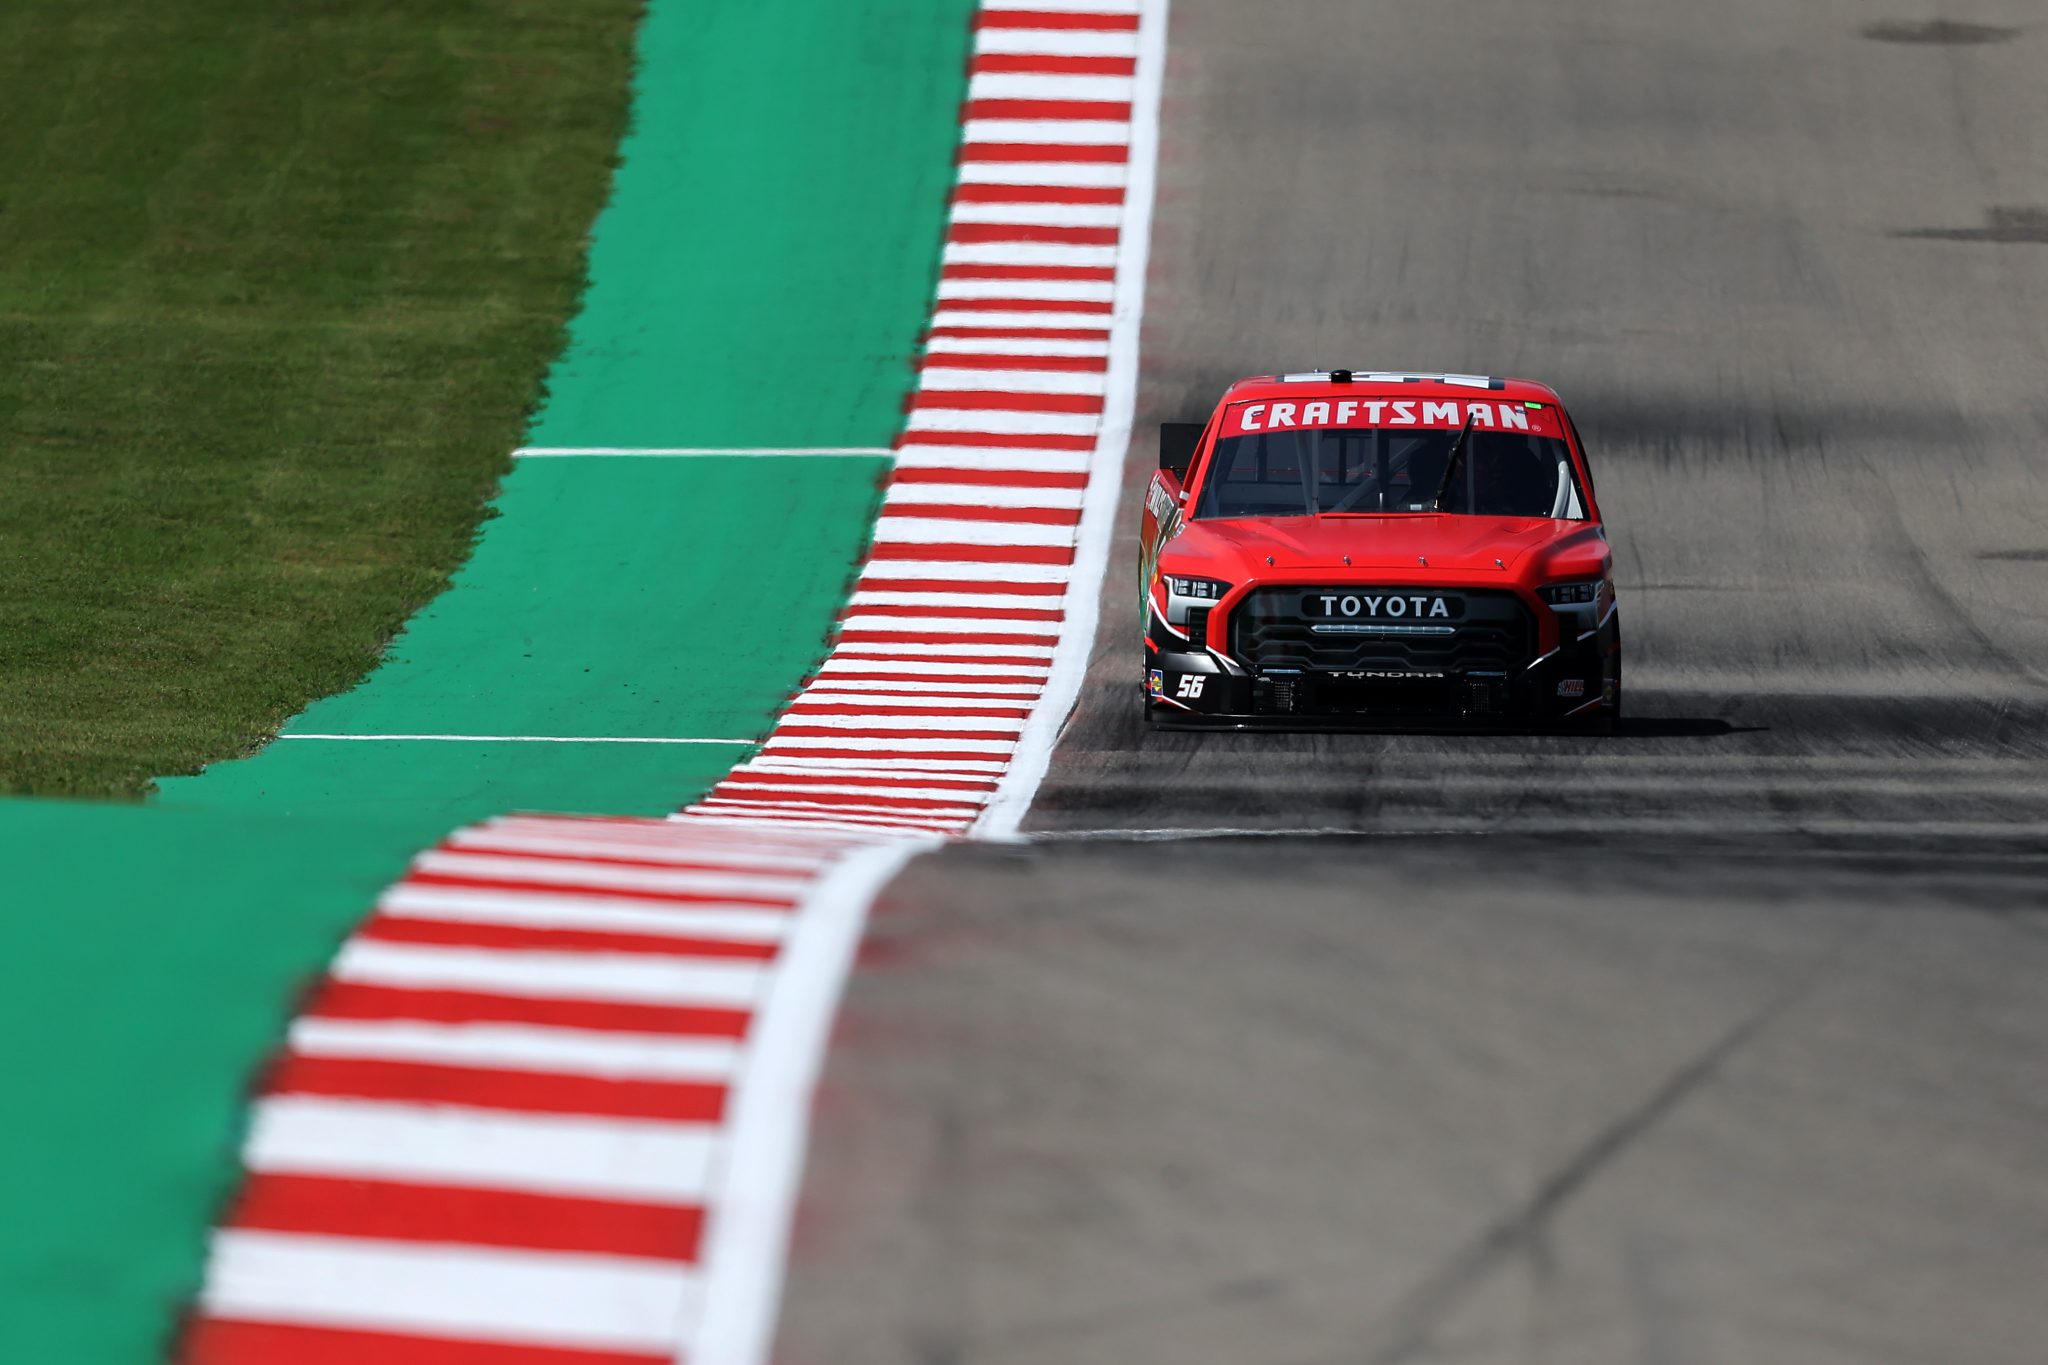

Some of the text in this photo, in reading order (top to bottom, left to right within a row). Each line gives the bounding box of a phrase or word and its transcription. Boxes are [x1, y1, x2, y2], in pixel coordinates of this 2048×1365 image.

[1240, 402, 1528, 430] CRAFTSMAN
[1320, 596, 1449, 617] TOYOTA
[1176, 674, 1206, 698] 56
